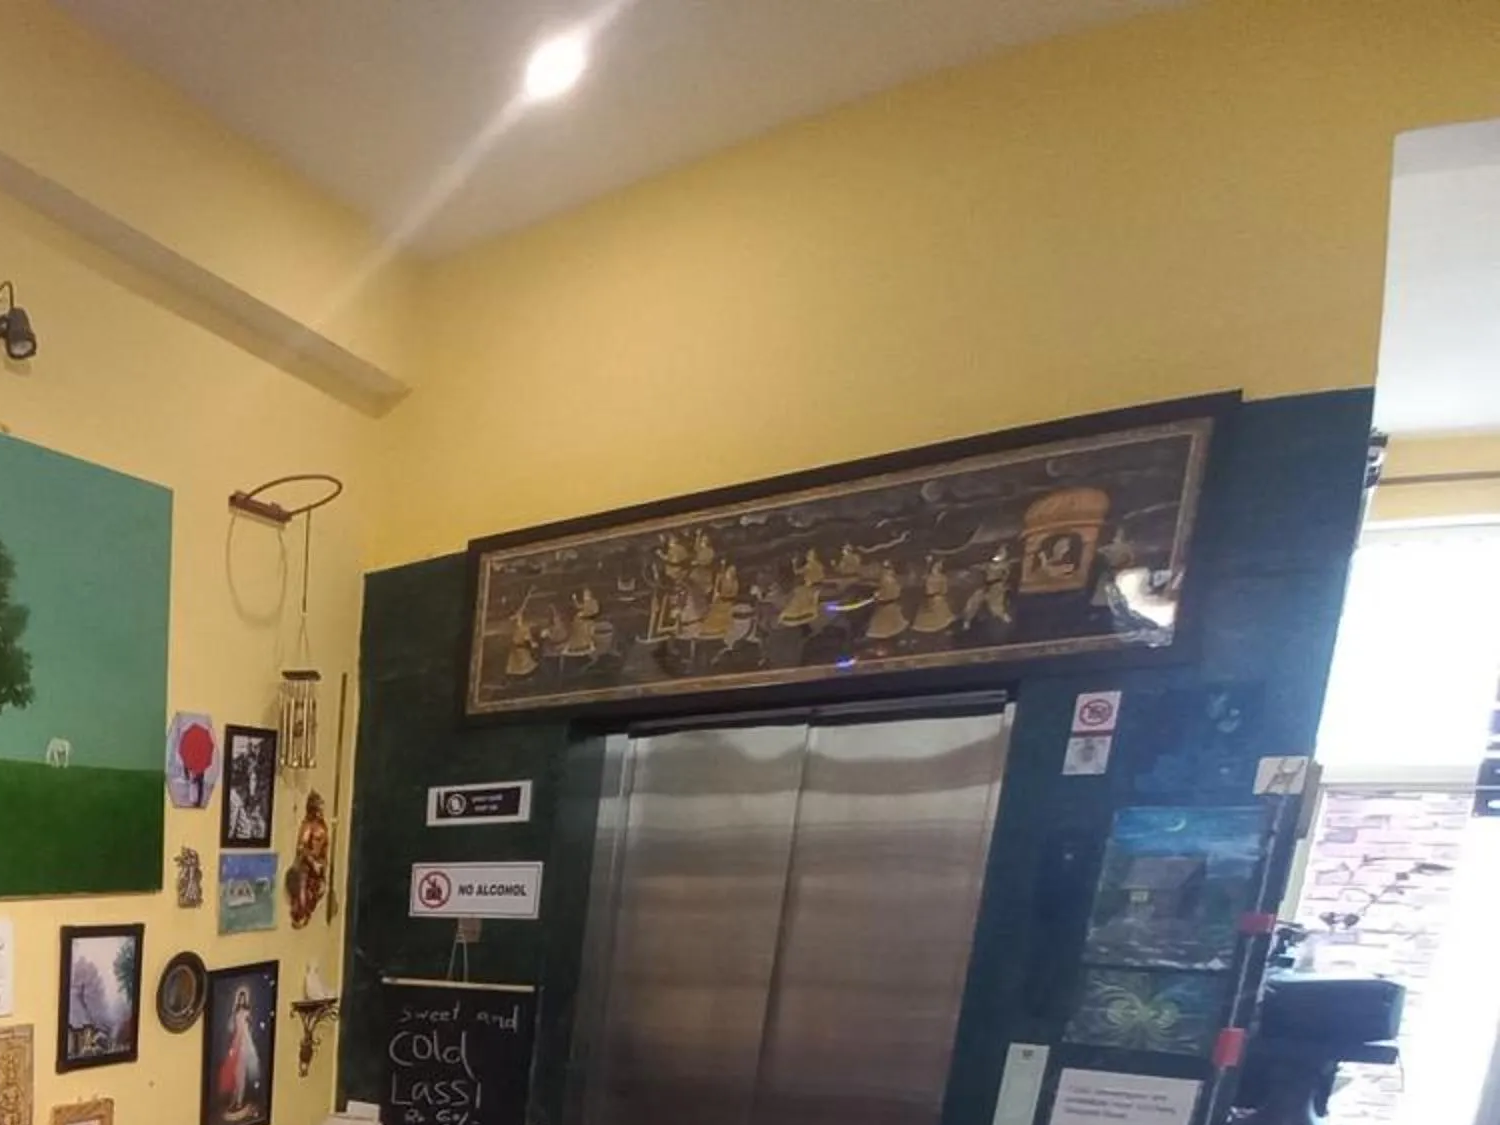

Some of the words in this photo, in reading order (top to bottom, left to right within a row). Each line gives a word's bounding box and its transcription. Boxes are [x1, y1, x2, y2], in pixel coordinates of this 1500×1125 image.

[458, 884, 474, 897] NO
[475, 884, 527, 897] ALCOHOL
[399, 1000, 462, 1023] sweet
[476, 1004, 520, 1033] and
